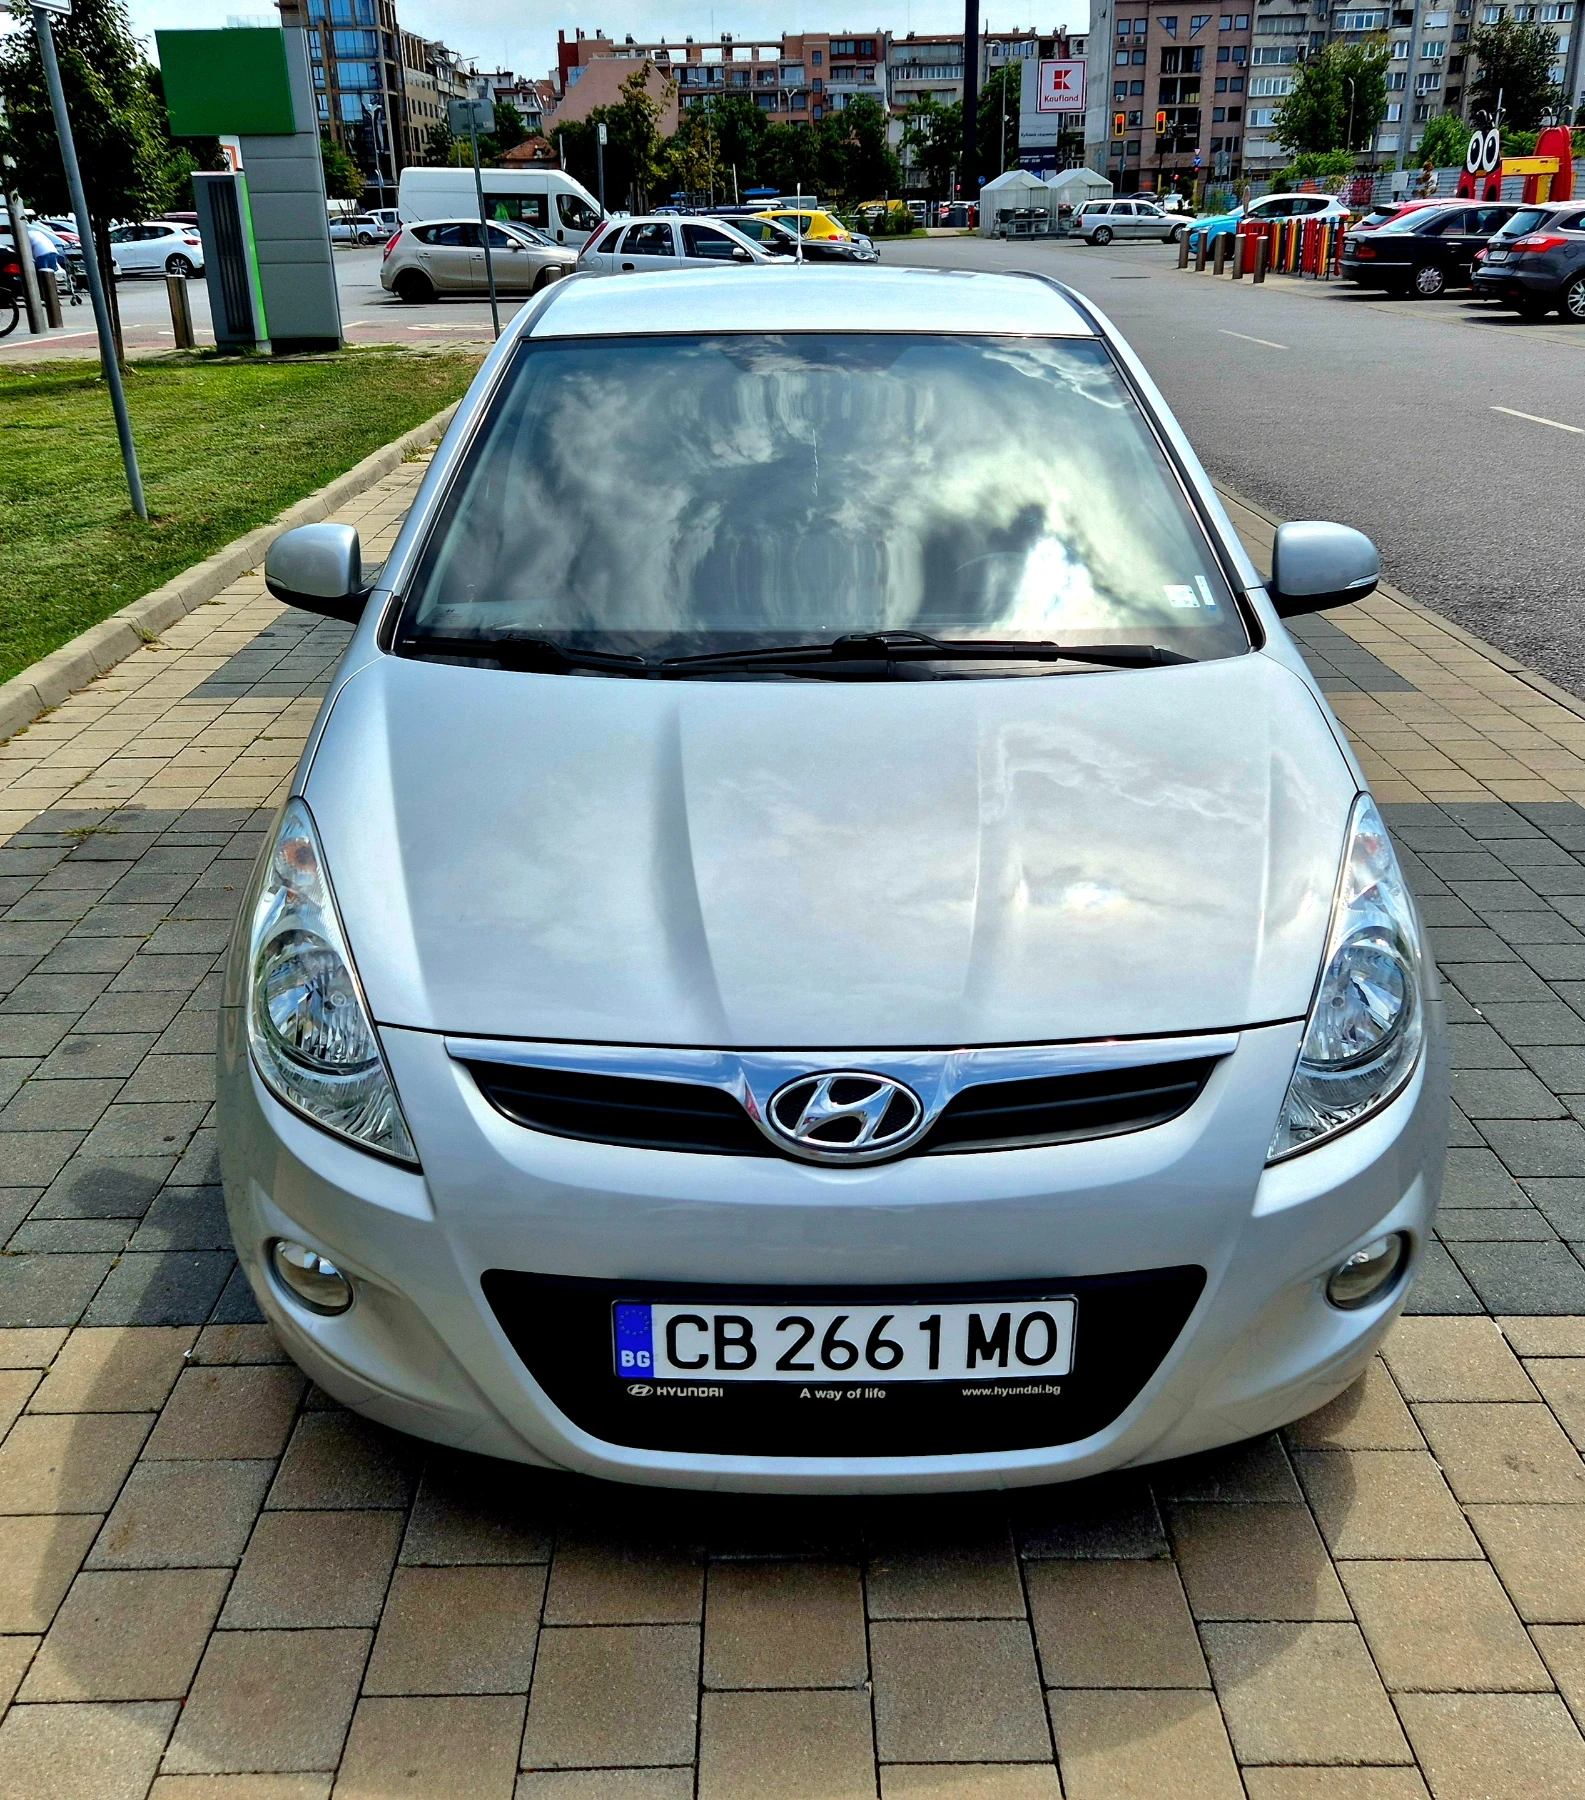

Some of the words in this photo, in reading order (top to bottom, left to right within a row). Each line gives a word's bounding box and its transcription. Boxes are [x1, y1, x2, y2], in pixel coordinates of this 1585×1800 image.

[1044, 94, 1079, 103] Kaufland
[666, 1314, 757, 1371] CB
[775, 1314, 941, 1371] 2661
[966, 1311, 1058, 1369] MO
[621, 1350, 650, 1368] BG
[656, 1386, 724, 1398] HYUNDAI
[800, 1388, 811, 1399] A
[814, 1390, 843, 1401] way
[847, 1388, 862, 1399] of
[865, 1388, 886, 1399] life
[962, 1384, 1061, 1397] www.hyundai.bg
